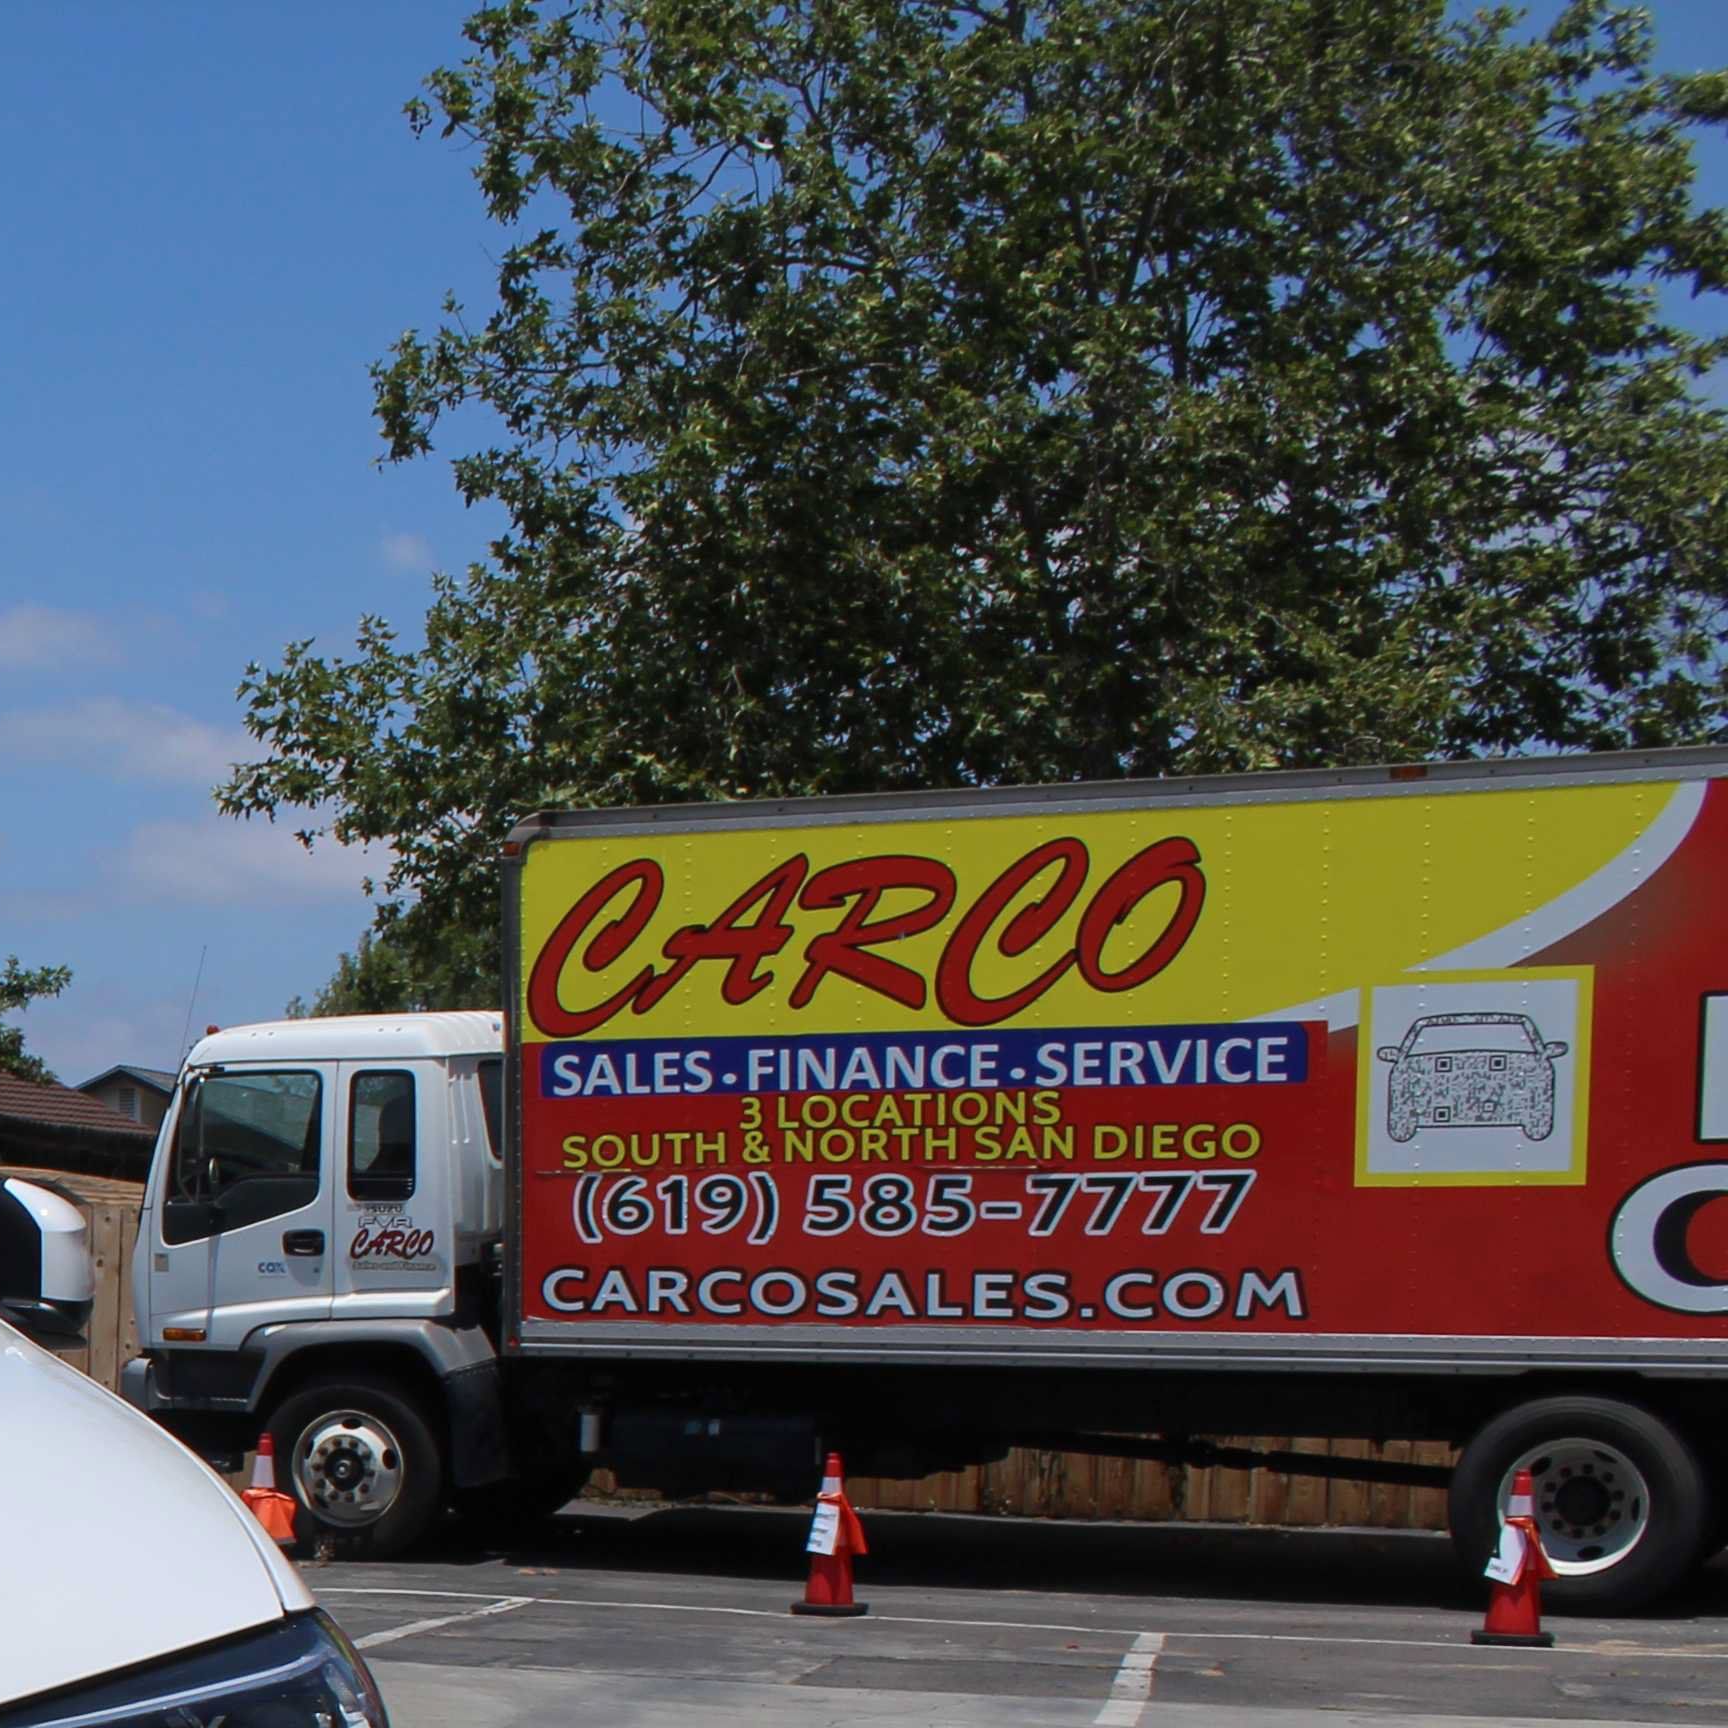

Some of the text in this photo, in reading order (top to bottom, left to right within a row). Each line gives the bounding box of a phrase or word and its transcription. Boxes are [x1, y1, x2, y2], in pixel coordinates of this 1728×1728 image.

[526, 834, 1206, 1038] CARCO
[553, 1037, 1288, 1097] SALES FINANCE SERVICE
[739, 1090, 1062, 1130] 3 LOCATIONS
[562, 1122, 1262, 1168] SOUTH & NORTH SAN DIEGO
[358, 1215, 414, 1229] FVR
[573, 1168, 1257, 1245] (619) 585-7777
[350, 1228, 435, 1260] CARCO
[541, 1267, 1305, 1320] CARCOSALES.COM
